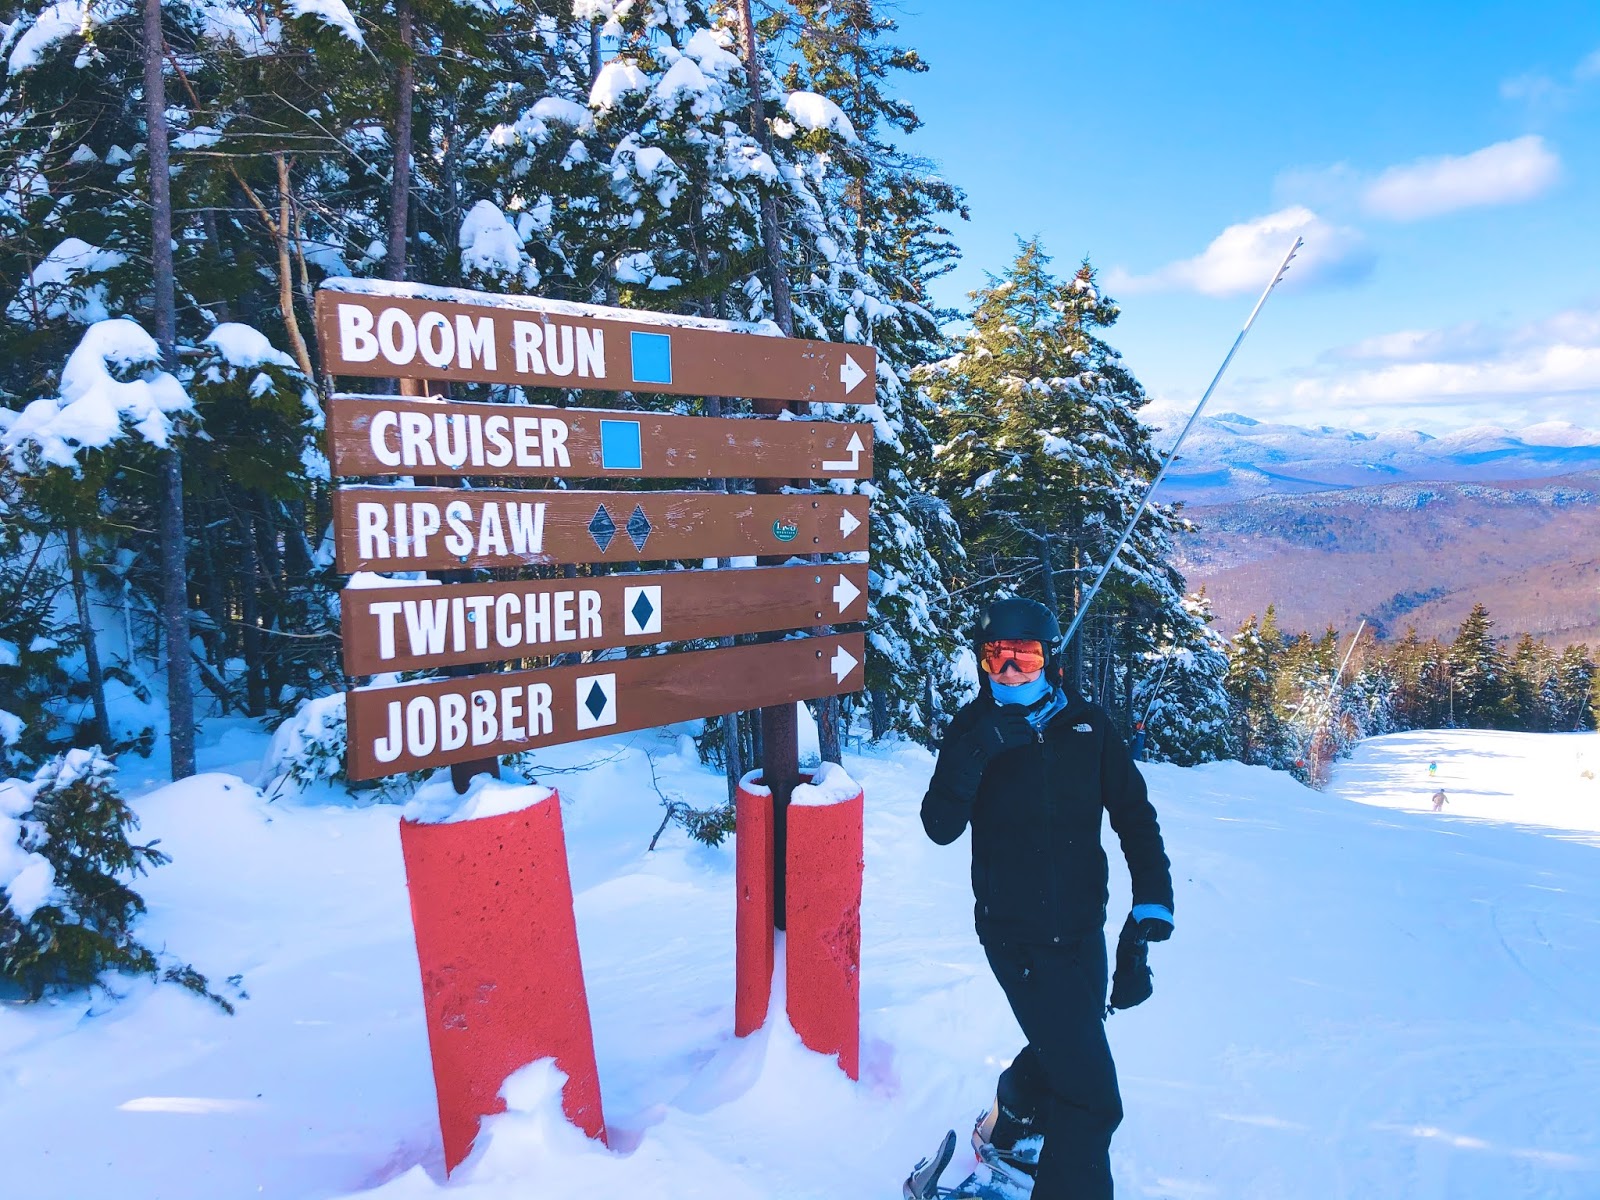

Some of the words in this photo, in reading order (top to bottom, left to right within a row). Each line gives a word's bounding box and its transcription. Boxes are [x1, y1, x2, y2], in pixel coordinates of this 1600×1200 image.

[338, 303, 498, 371] BOOM
[514, 320, 606, 379] RUN
[369, 410, 572, 468] CRUISER
[357, 501, 546, 560] RIPSAW
[369, 590, 603, 660] TWITCHER
[374, 683, 553, 763] JOBBER
